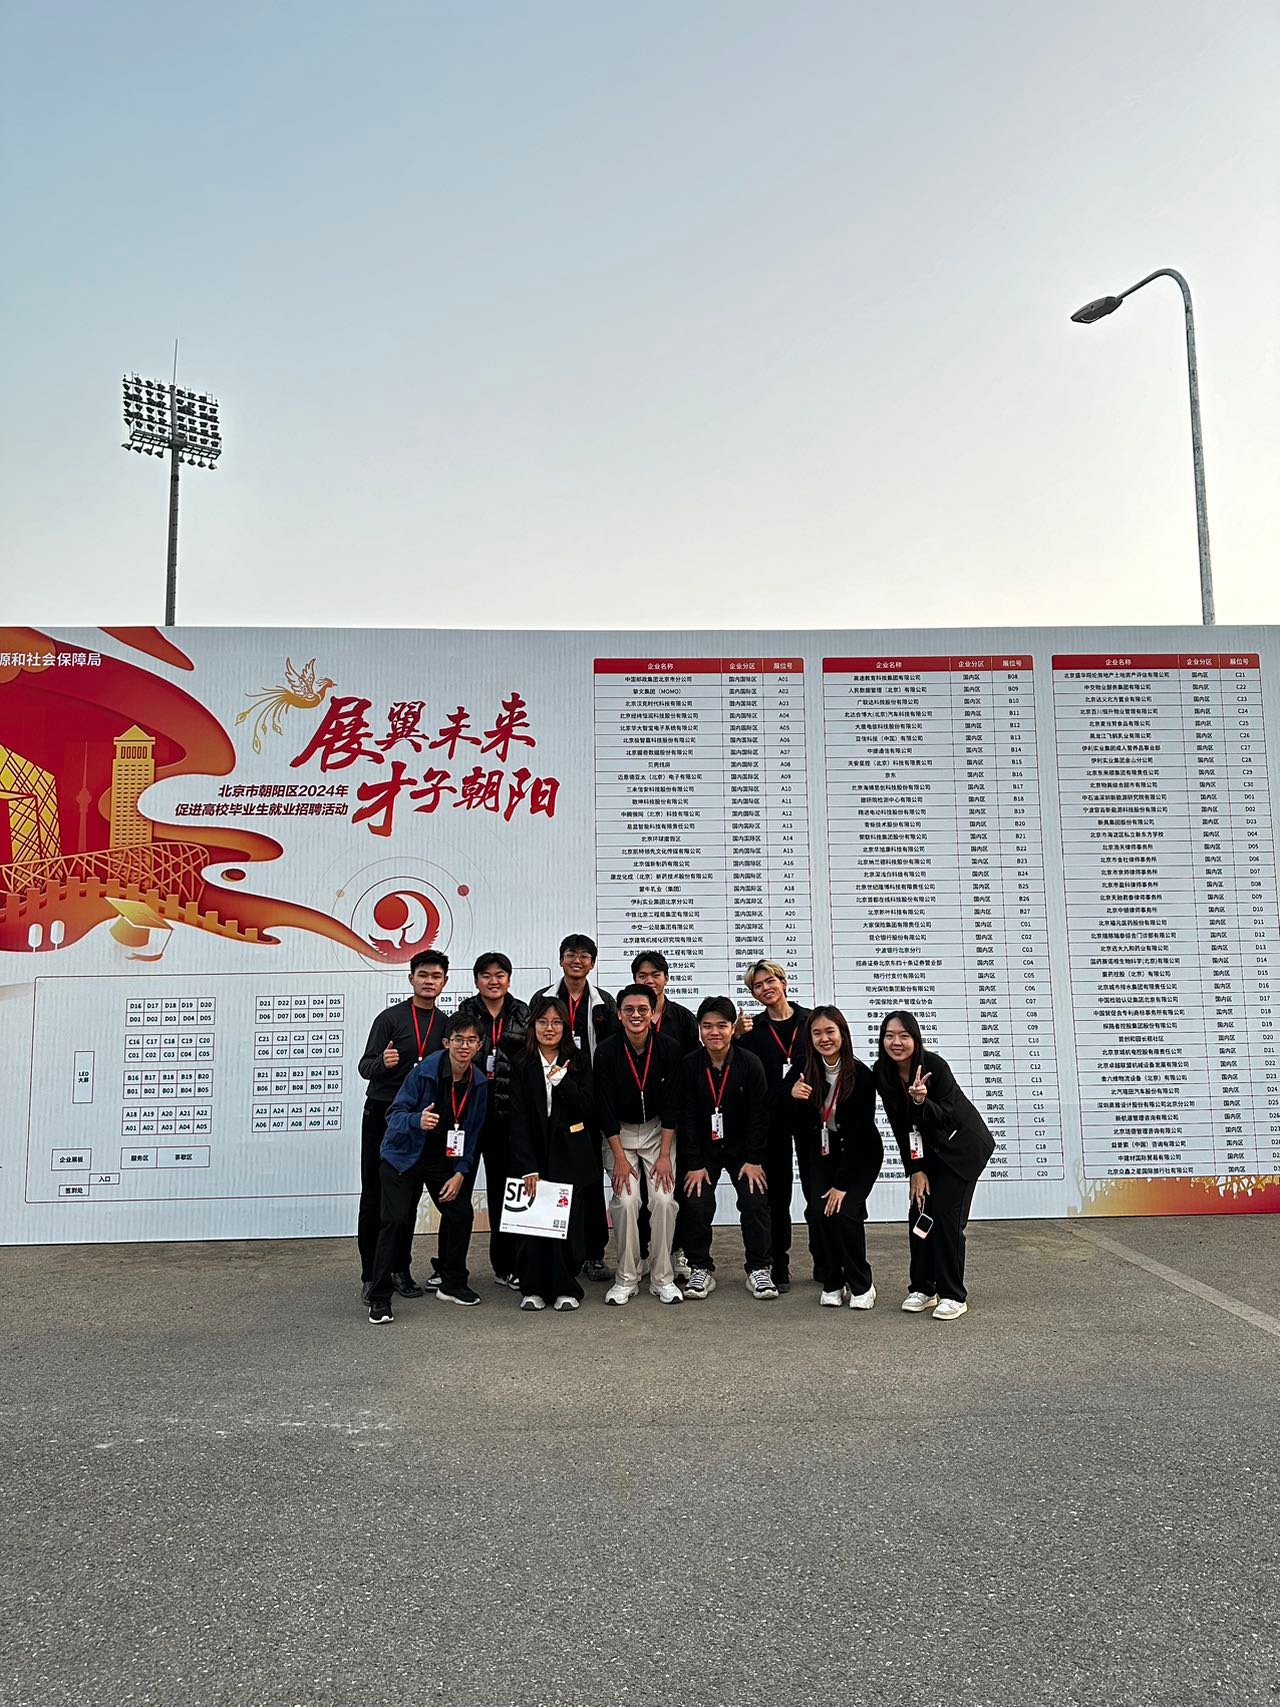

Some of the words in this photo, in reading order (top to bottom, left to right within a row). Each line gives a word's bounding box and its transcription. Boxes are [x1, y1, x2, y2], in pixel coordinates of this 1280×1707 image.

[0, 652, 101, 667] 源和社会保障局
[647, 662, 674, 671] 企业名称
[729, 662, 756, 671] 企业分区
[772, 662, 793, 671] 展位号
[875, 662, 903, 670] 企业名称
[958, 660, 985, 668] 企业分区
[1002, 659, 1022, 667] 展位号
[1104, 658, 1132, 667] 企业名称
[1186, 658, 1213, 666] 企业分区
[1229, 658, 1249, 666] 展位号
[289, 691, 537, 773] 展翼未来
[217, 783, 349, 798] 北京市朝阳区2024年
[351, 760, 561, 837] 才子朝阳
[174, 802, 349, 817] 促进高校毕业生就业招聘活动
